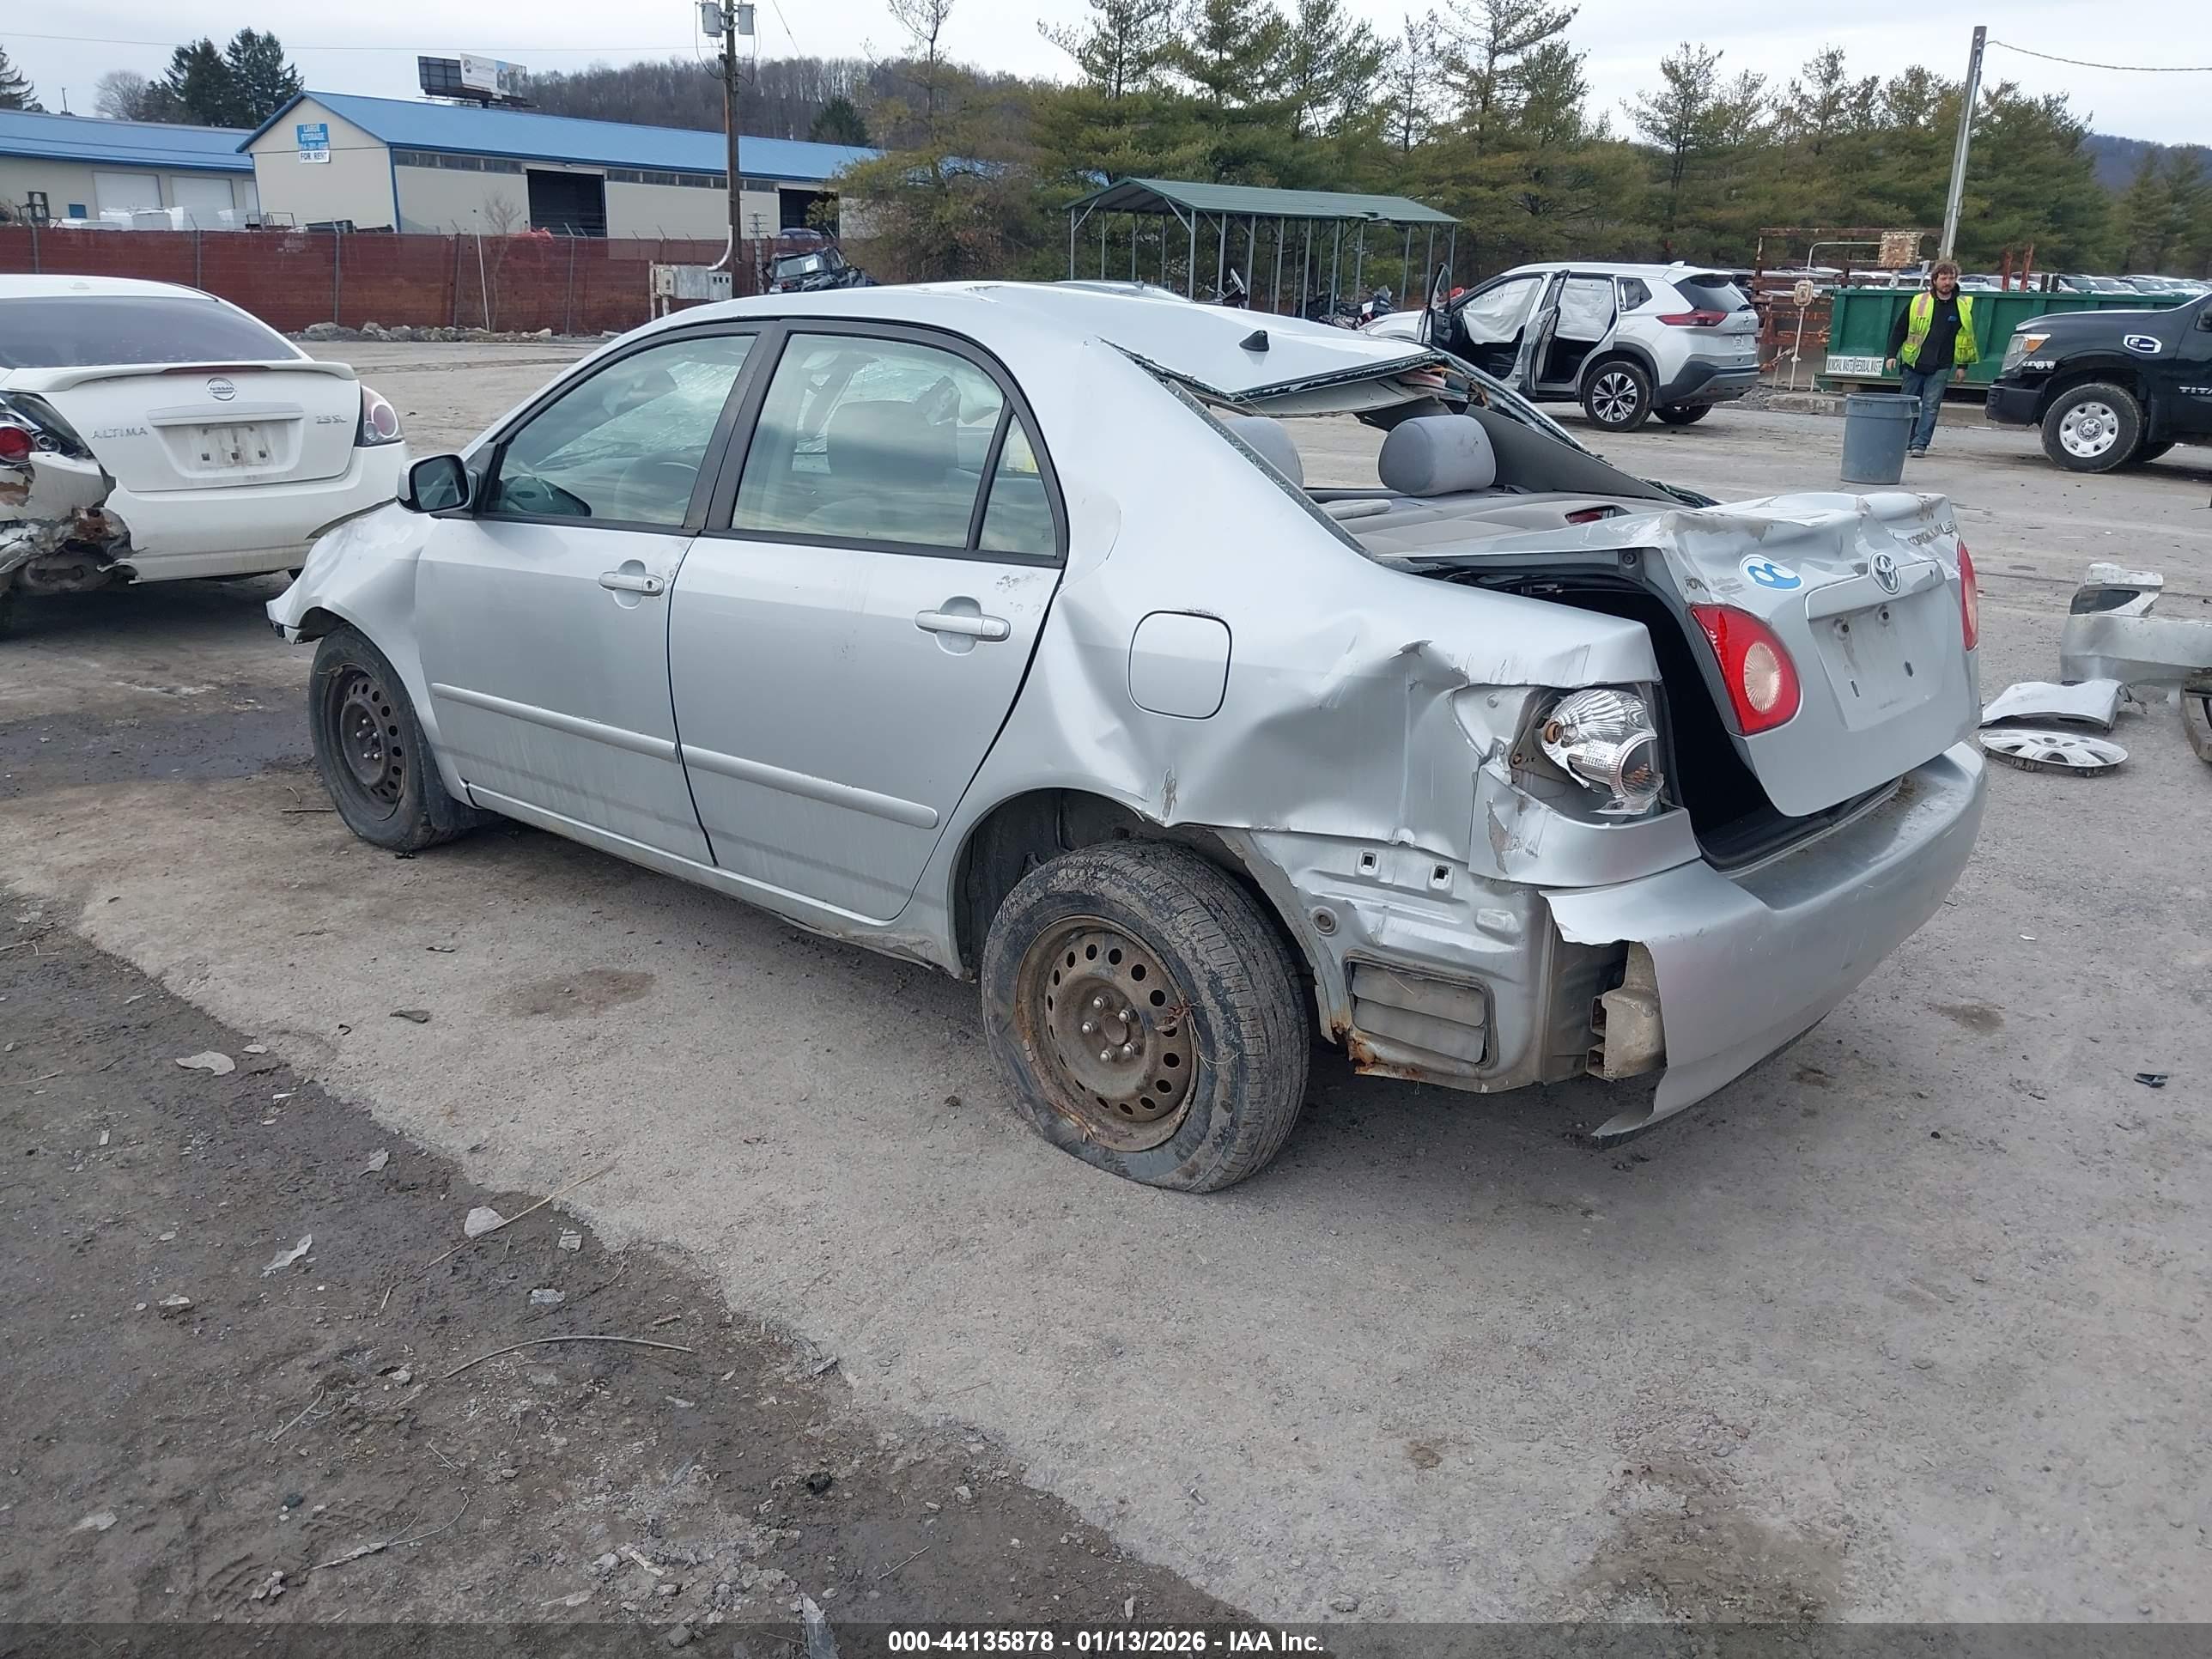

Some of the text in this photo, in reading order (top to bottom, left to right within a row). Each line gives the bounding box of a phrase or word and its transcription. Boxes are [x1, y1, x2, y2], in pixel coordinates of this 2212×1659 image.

[300, 151, 328, 161] FOR RENT
[90, 427, 149, 439] ALTIMA
